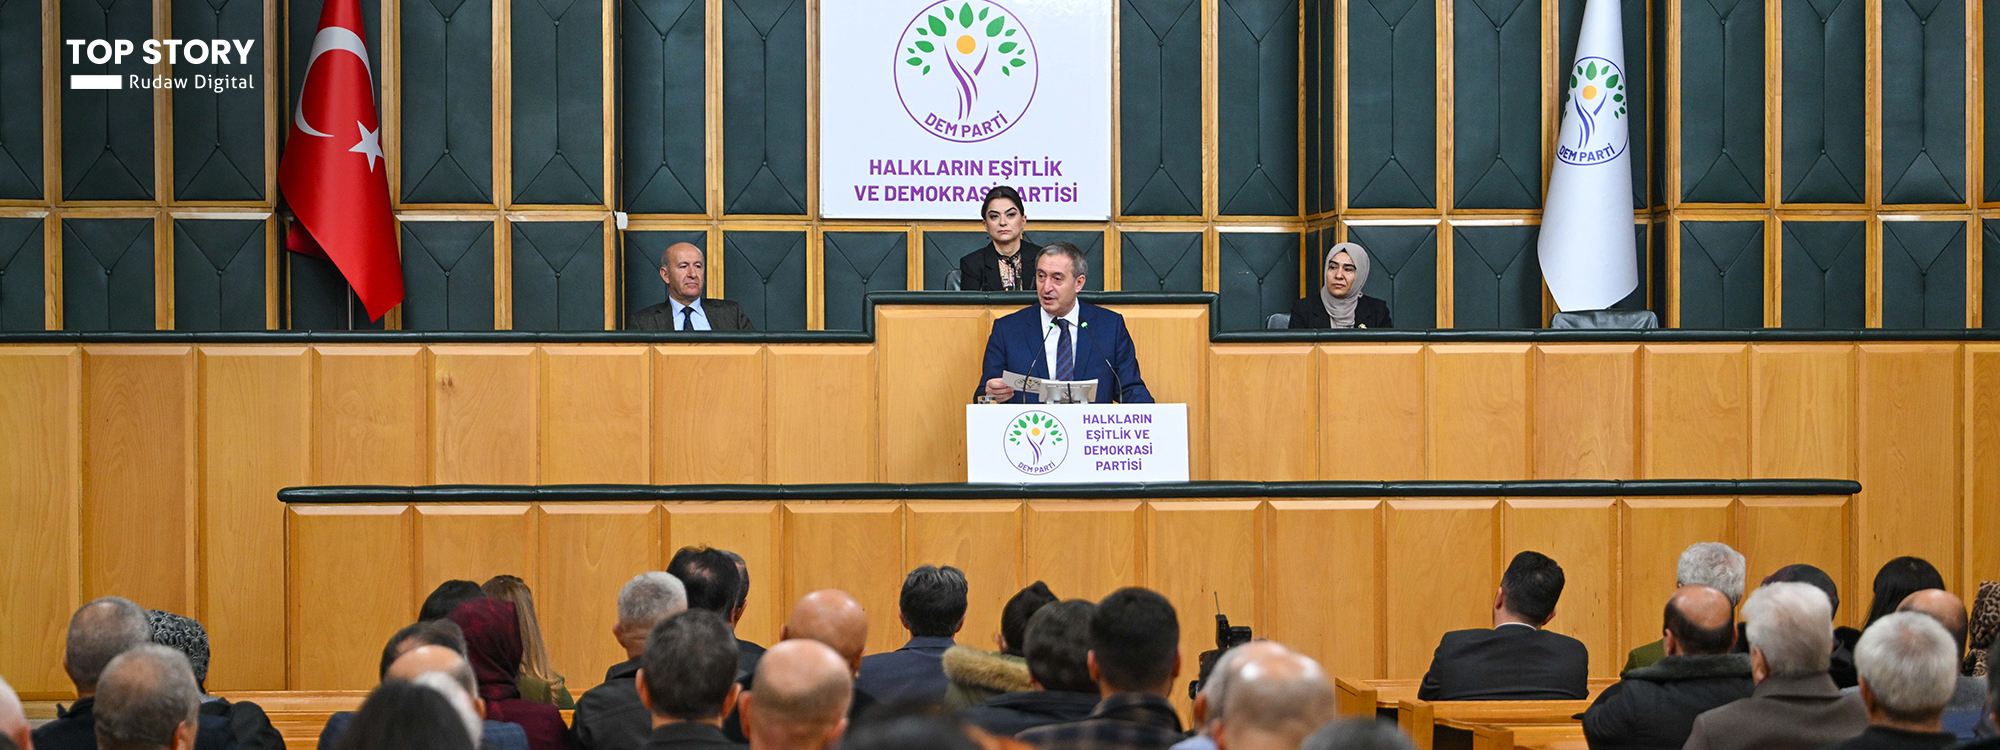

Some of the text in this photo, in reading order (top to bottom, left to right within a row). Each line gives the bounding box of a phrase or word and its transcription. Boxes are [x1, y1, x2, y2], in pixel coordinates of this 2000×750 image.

[924, 110, 1009, 138] DEM PARTİ
[1558, 142, 1616, 162] DEM PARTİ
[869, 156, 1063, 180] HALKLARIN EŞİTLİK
[854, 182, 1078, 203] VE DEMOKRAS ARTİSİ
[1083, 413, 1152, 424] HALKLARIN
[1086, 427, 1150, 442] EŞİTLİK VE
[1084, 441, 1153, 455] DEMOKRASİ
[1017, 460, 1056, 474] DEM PARTİ
[1096, 458, 1142, 471] PARTİSİ
